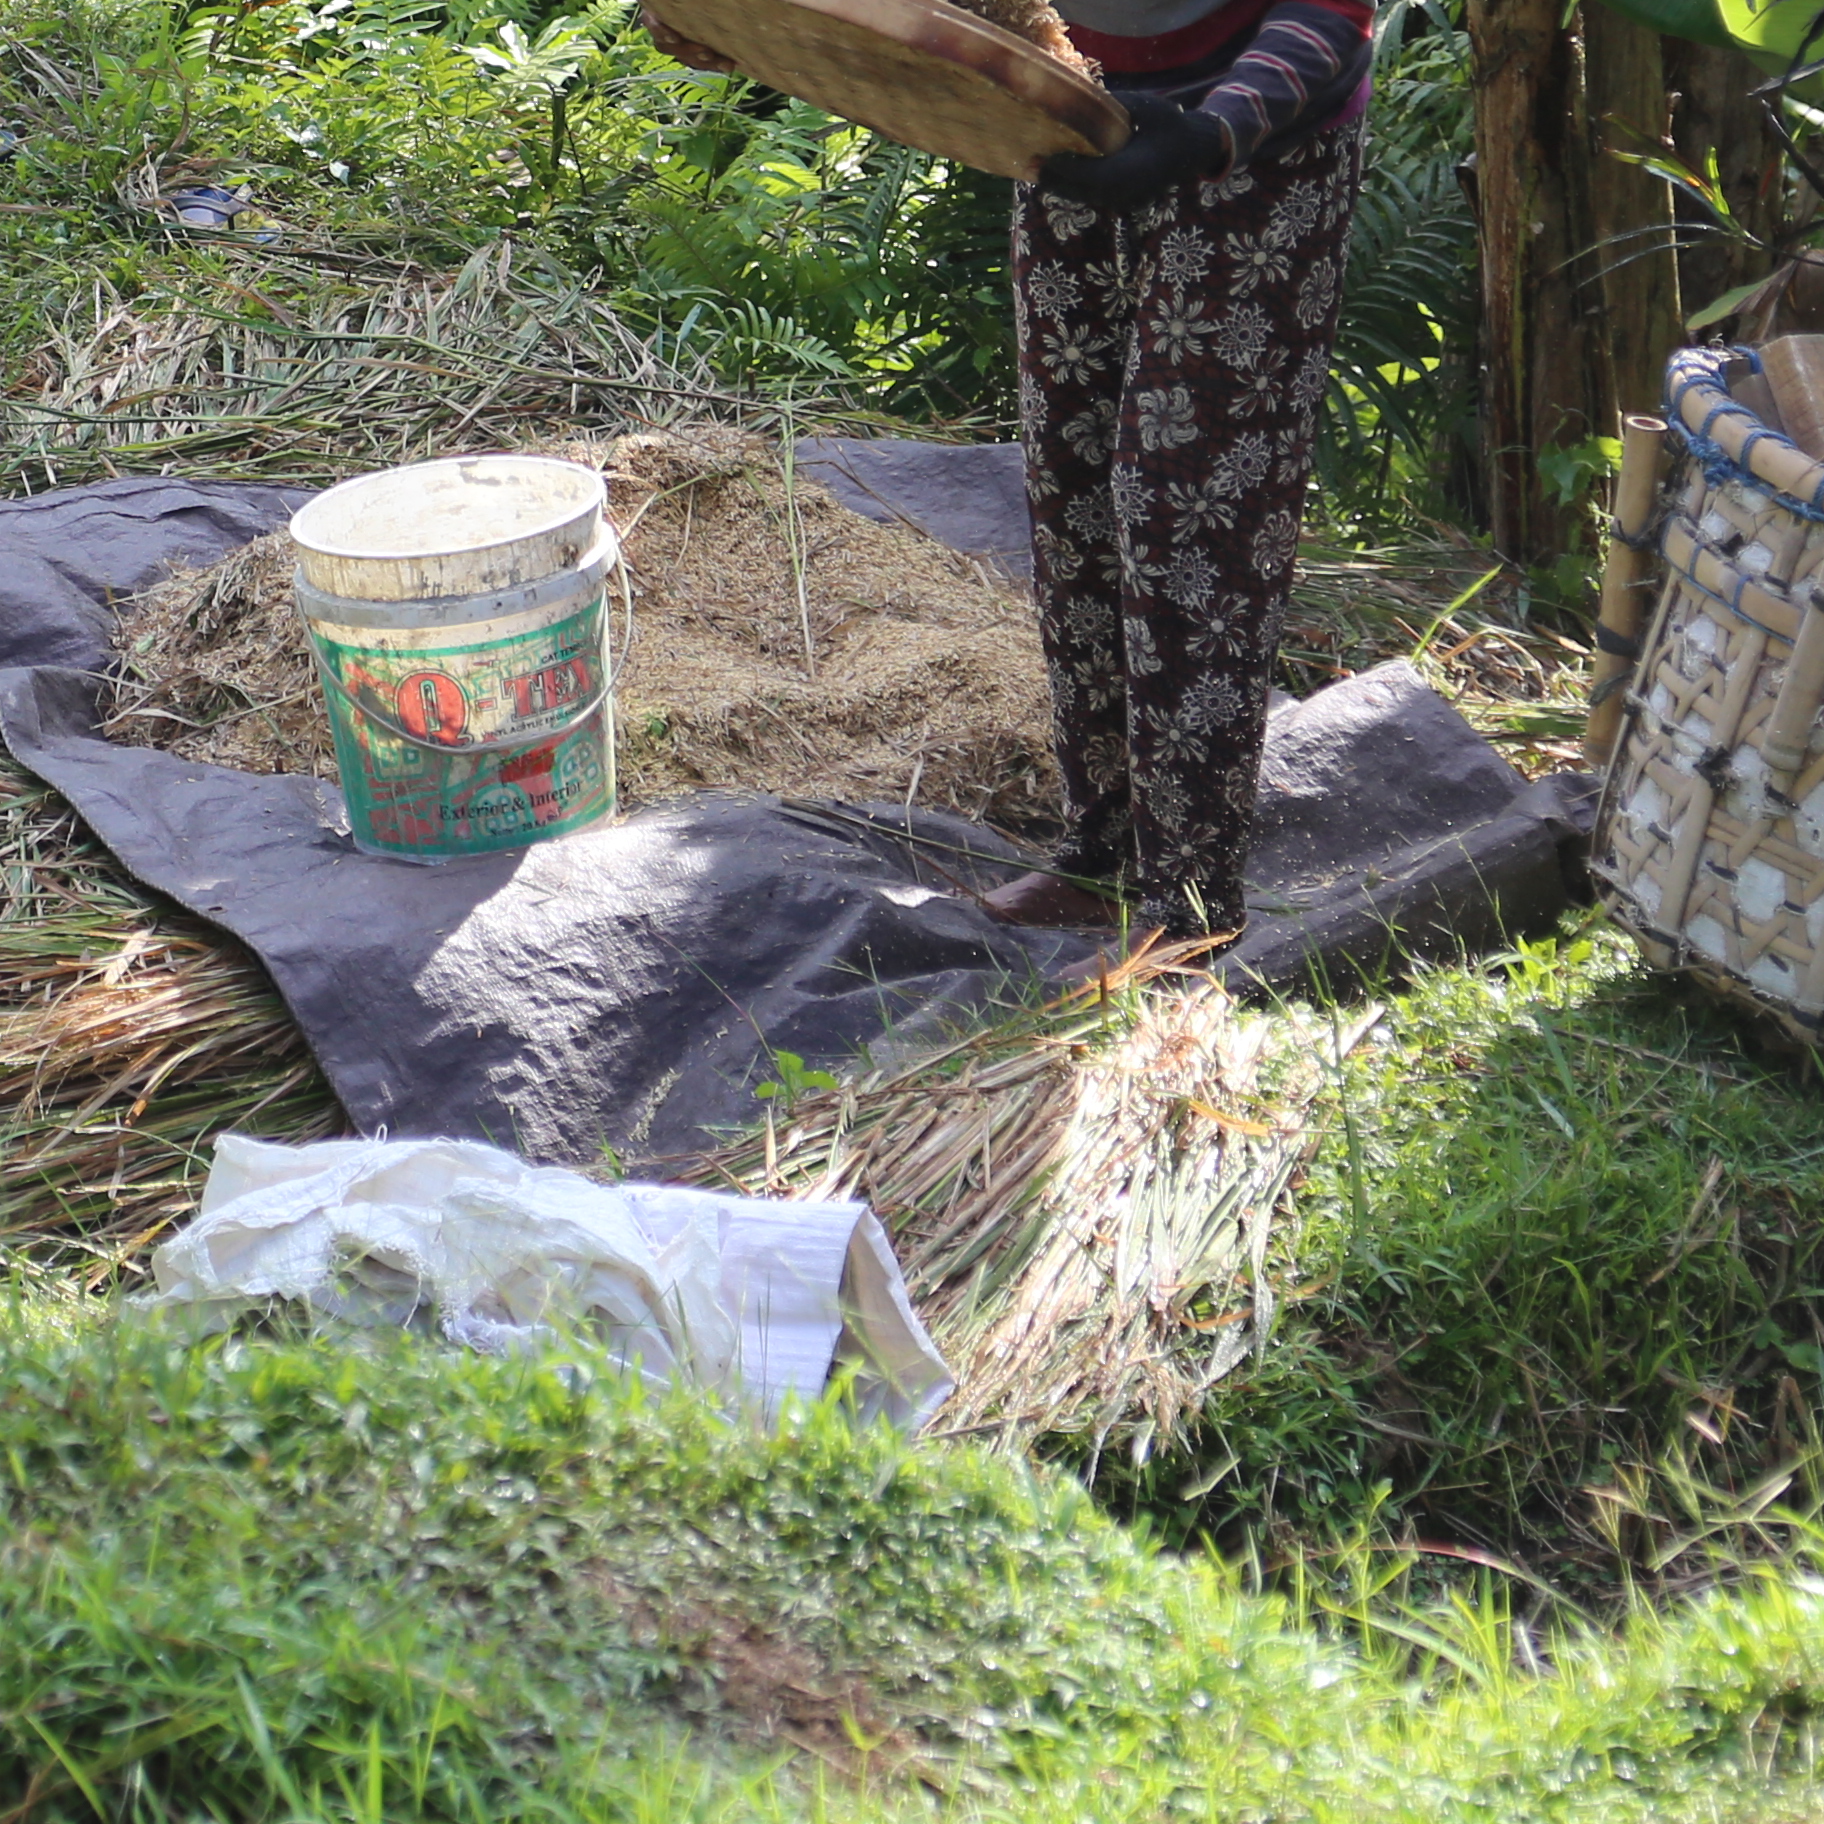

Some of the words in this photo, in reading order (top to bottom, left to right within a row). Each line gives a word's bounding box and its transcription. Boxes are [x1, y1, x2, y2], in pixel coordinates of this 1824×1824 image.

[438, 801, 509, 821] Exterior
[511, 796, 526, 812] &
[529, 782, 583, 806] Interior
